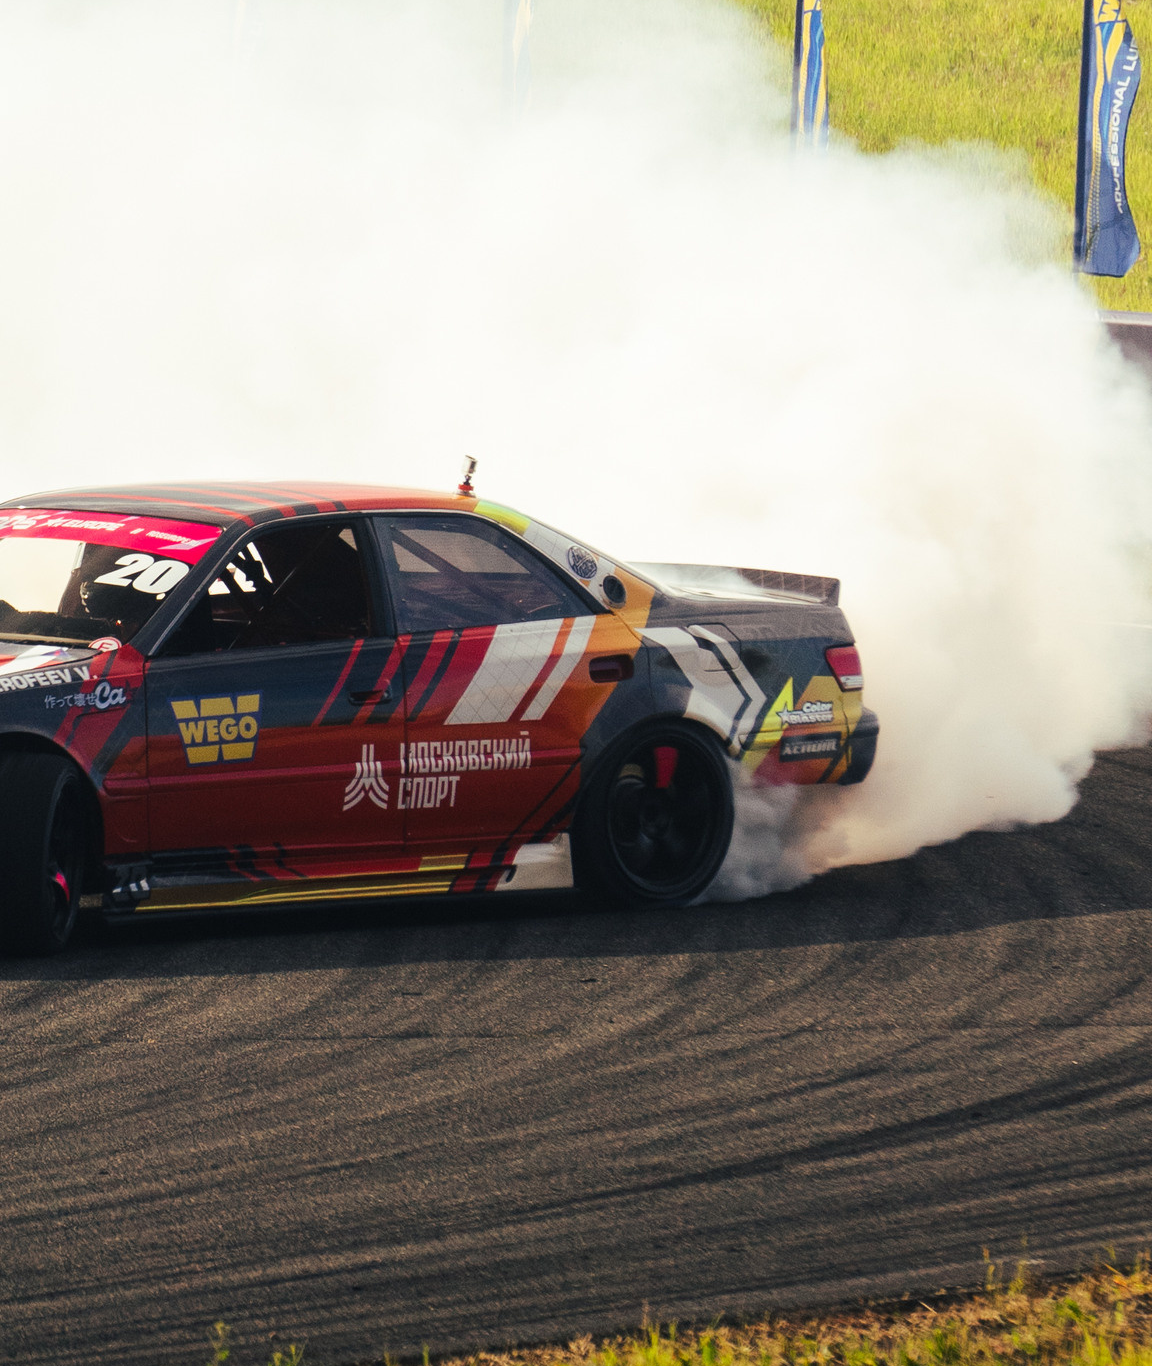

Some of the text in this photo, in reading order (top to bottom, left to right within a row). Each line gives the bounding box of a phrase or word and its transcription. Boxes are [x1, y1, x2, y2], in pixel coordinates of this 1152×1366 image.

[61, 518, 126, 532] EUROPE
[94, 552, 190, 595] 20
[75, 665, 98, 682] V.
[802, 700, 833, 714] Color
[178, 715, 258, 745] WEGO
[789, 713, 834, 725] Blaster
[400, 730, 532, 774] МОСКОВСКИЙ
[397, 775, 461, 810] СПОРТ
